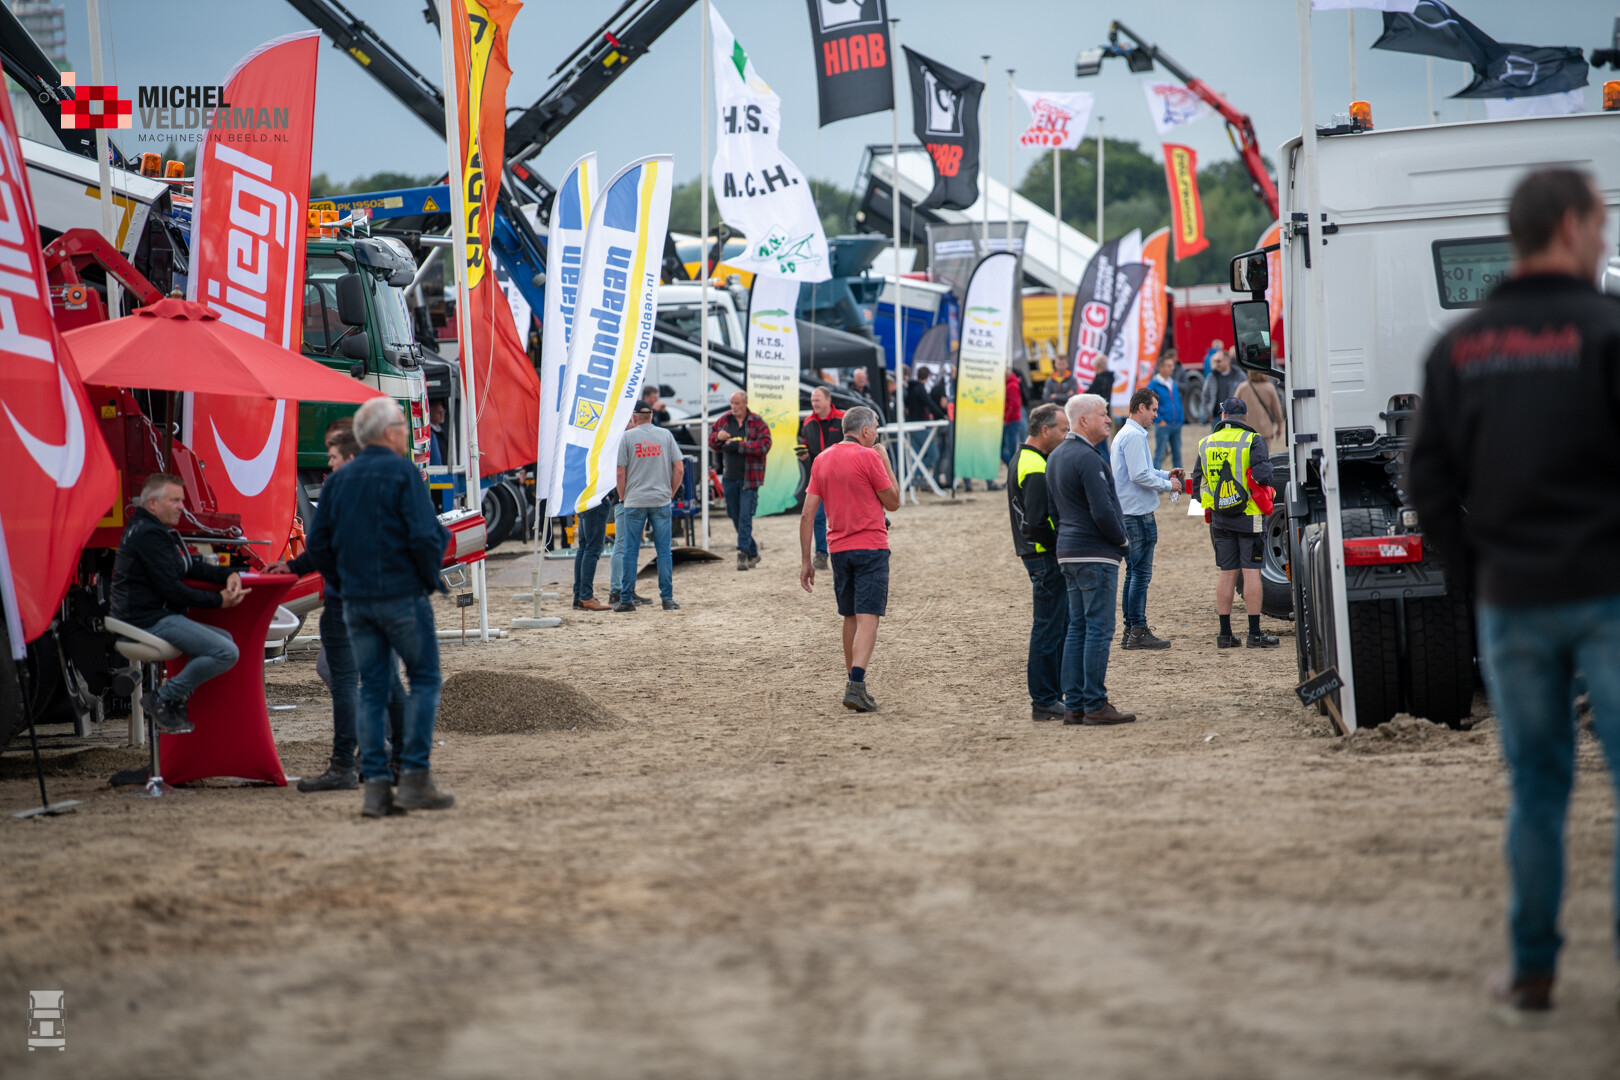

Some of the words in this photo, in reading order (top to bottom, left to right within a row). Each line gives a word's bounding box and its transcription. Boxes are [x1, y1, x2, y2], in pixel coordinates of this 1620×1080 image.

[823, 32, 887, 77] HIAB
[208, 143, 288, 340] liegl
[570, 246, 632, 422] Rondaan
[624, 273, 656, 400] www.rondaan.nl
[757, 336, 785, 347] H.T.S.
[755, 349, 785, 361] N.C.H.
[750, 373, 782, 382] specialist
[753, 382, 785, 391] transport
[754, 391, 783, 400] logistics
[1300, 677, 1339, 705] Scania
